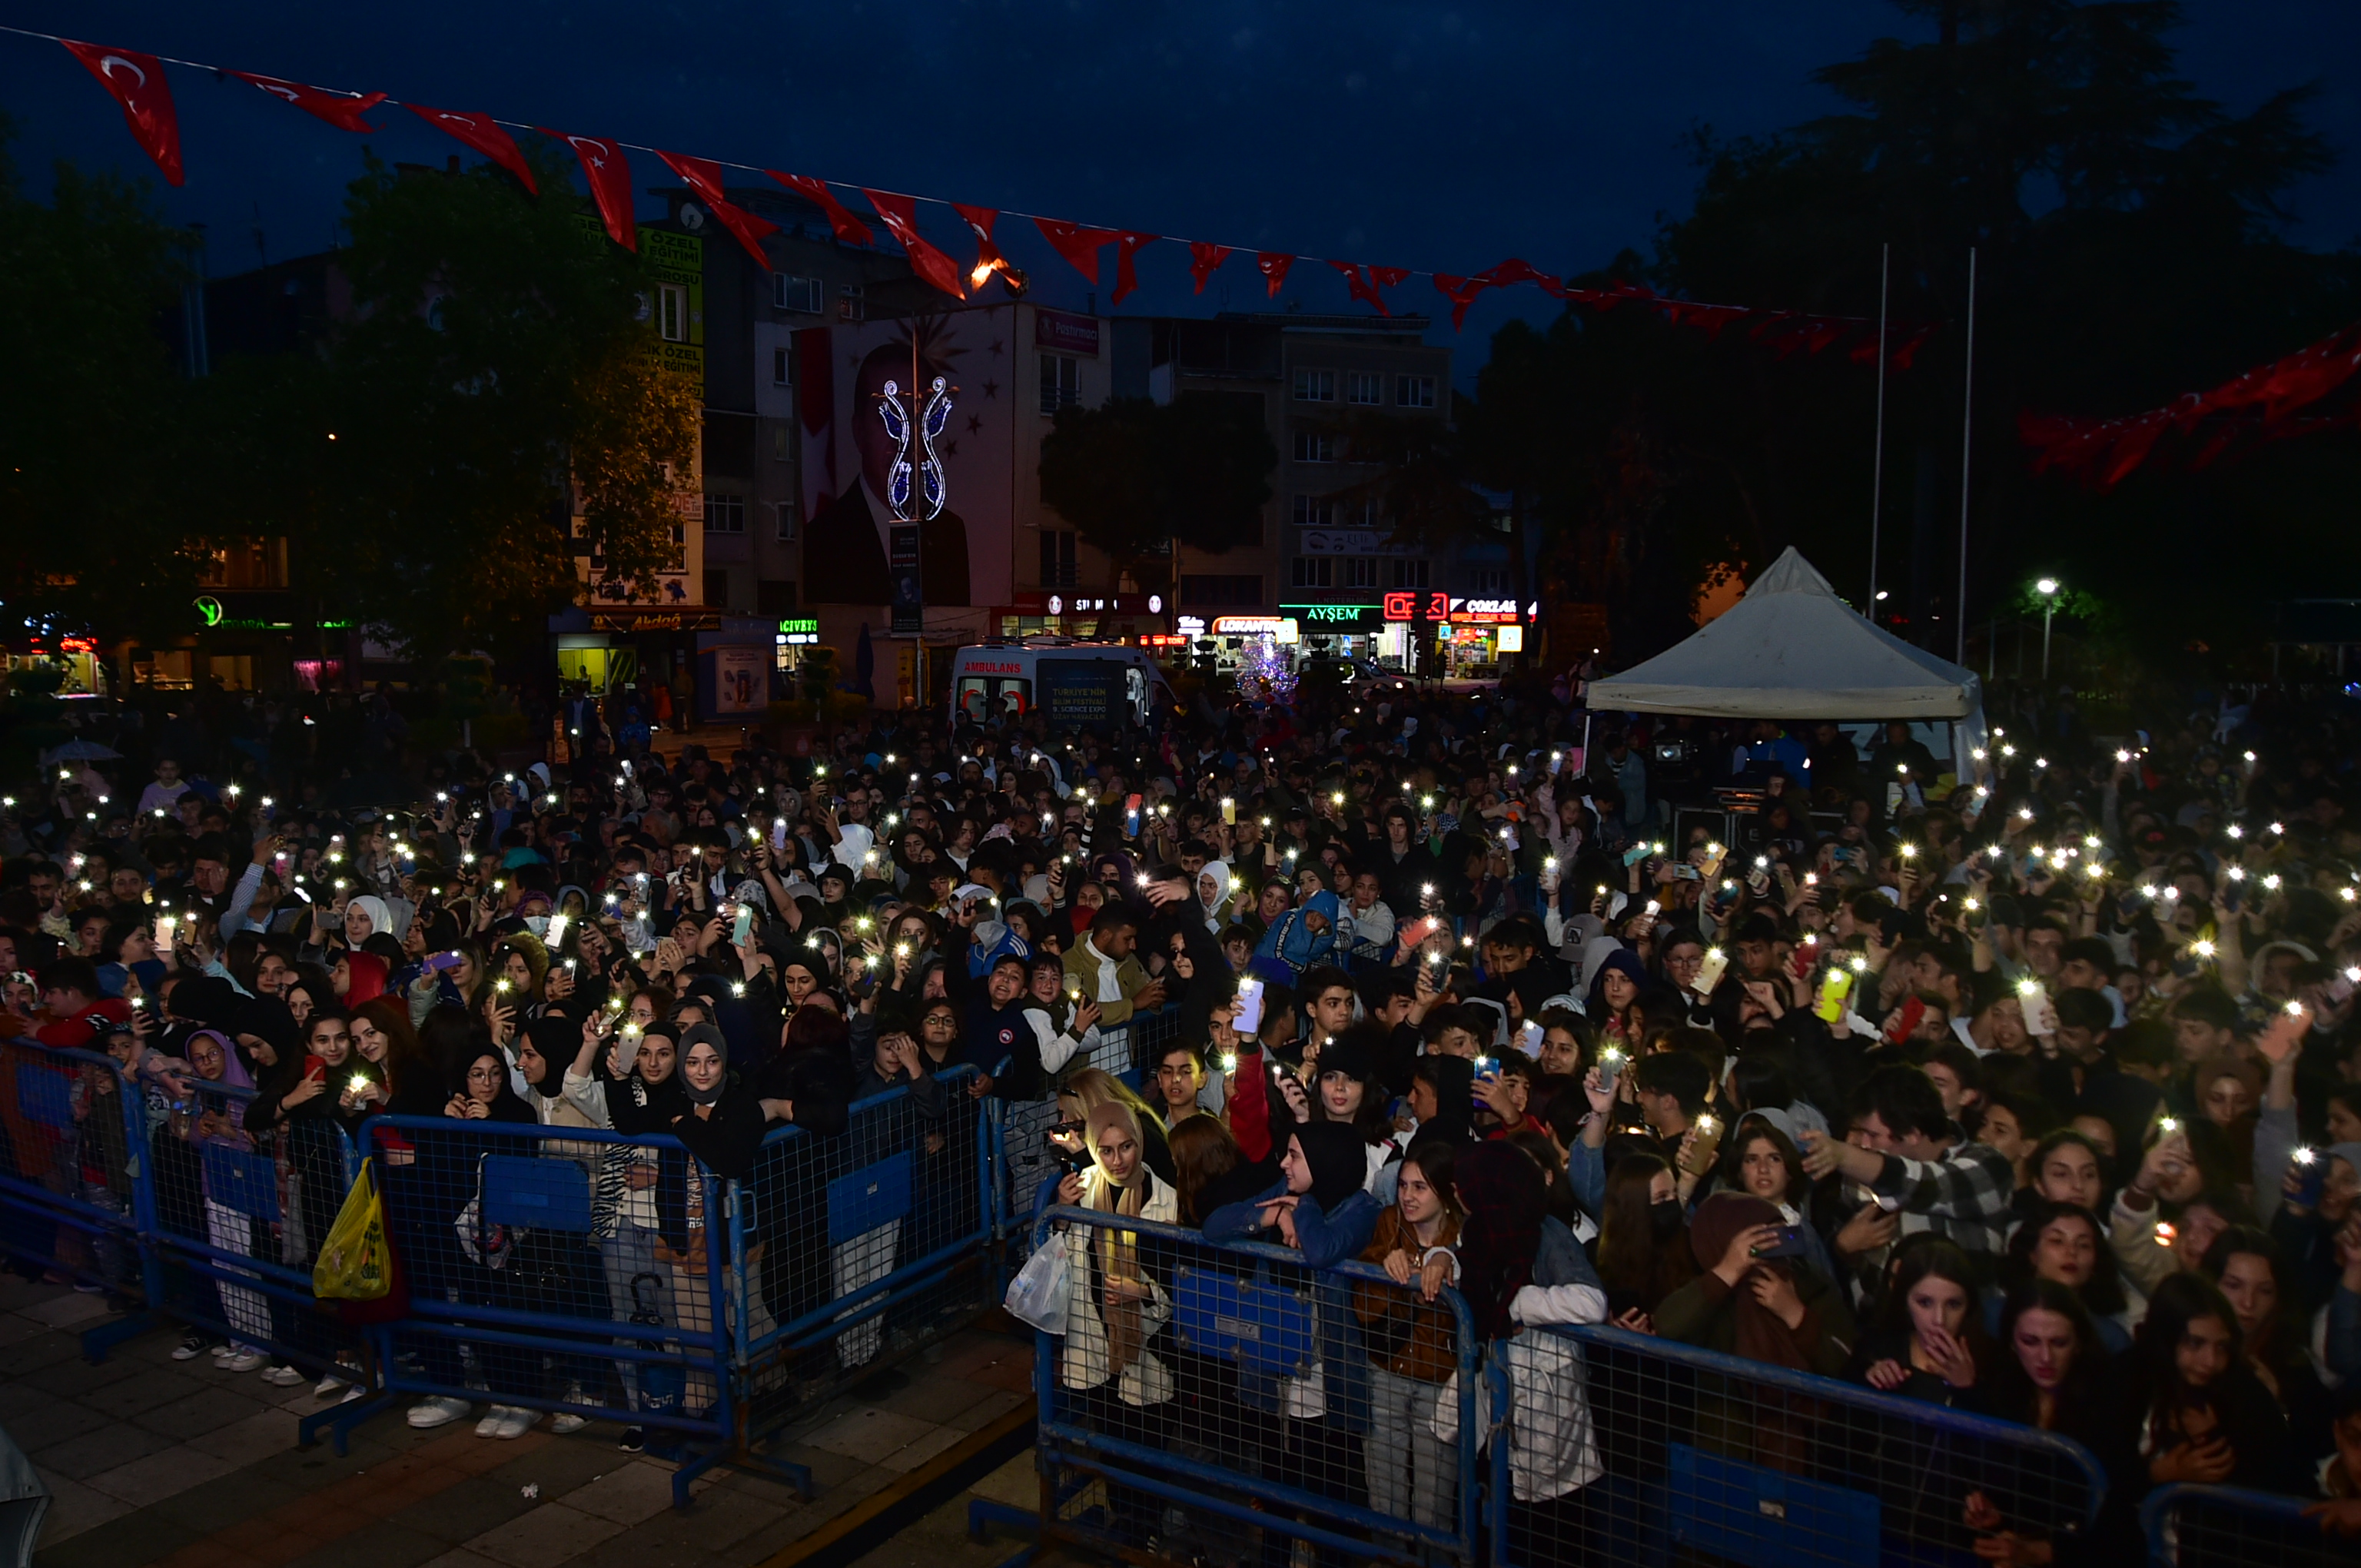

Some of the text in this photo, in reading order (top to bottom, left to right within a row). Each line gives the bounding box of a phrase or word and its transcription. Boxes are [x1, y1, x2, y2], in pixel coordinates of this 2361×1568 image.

[650, 231, 699, 251] ÖZEL
[649, 245, 699, 263] EĞİTİMİ
[665, 344, 700, 361] ÖZEL
[664, 359, 700, 375] EĞİTİMİ
[1307, 608, 1359, 623] AYŞEM
[965, 662, 1021, 673] AMBULANS
